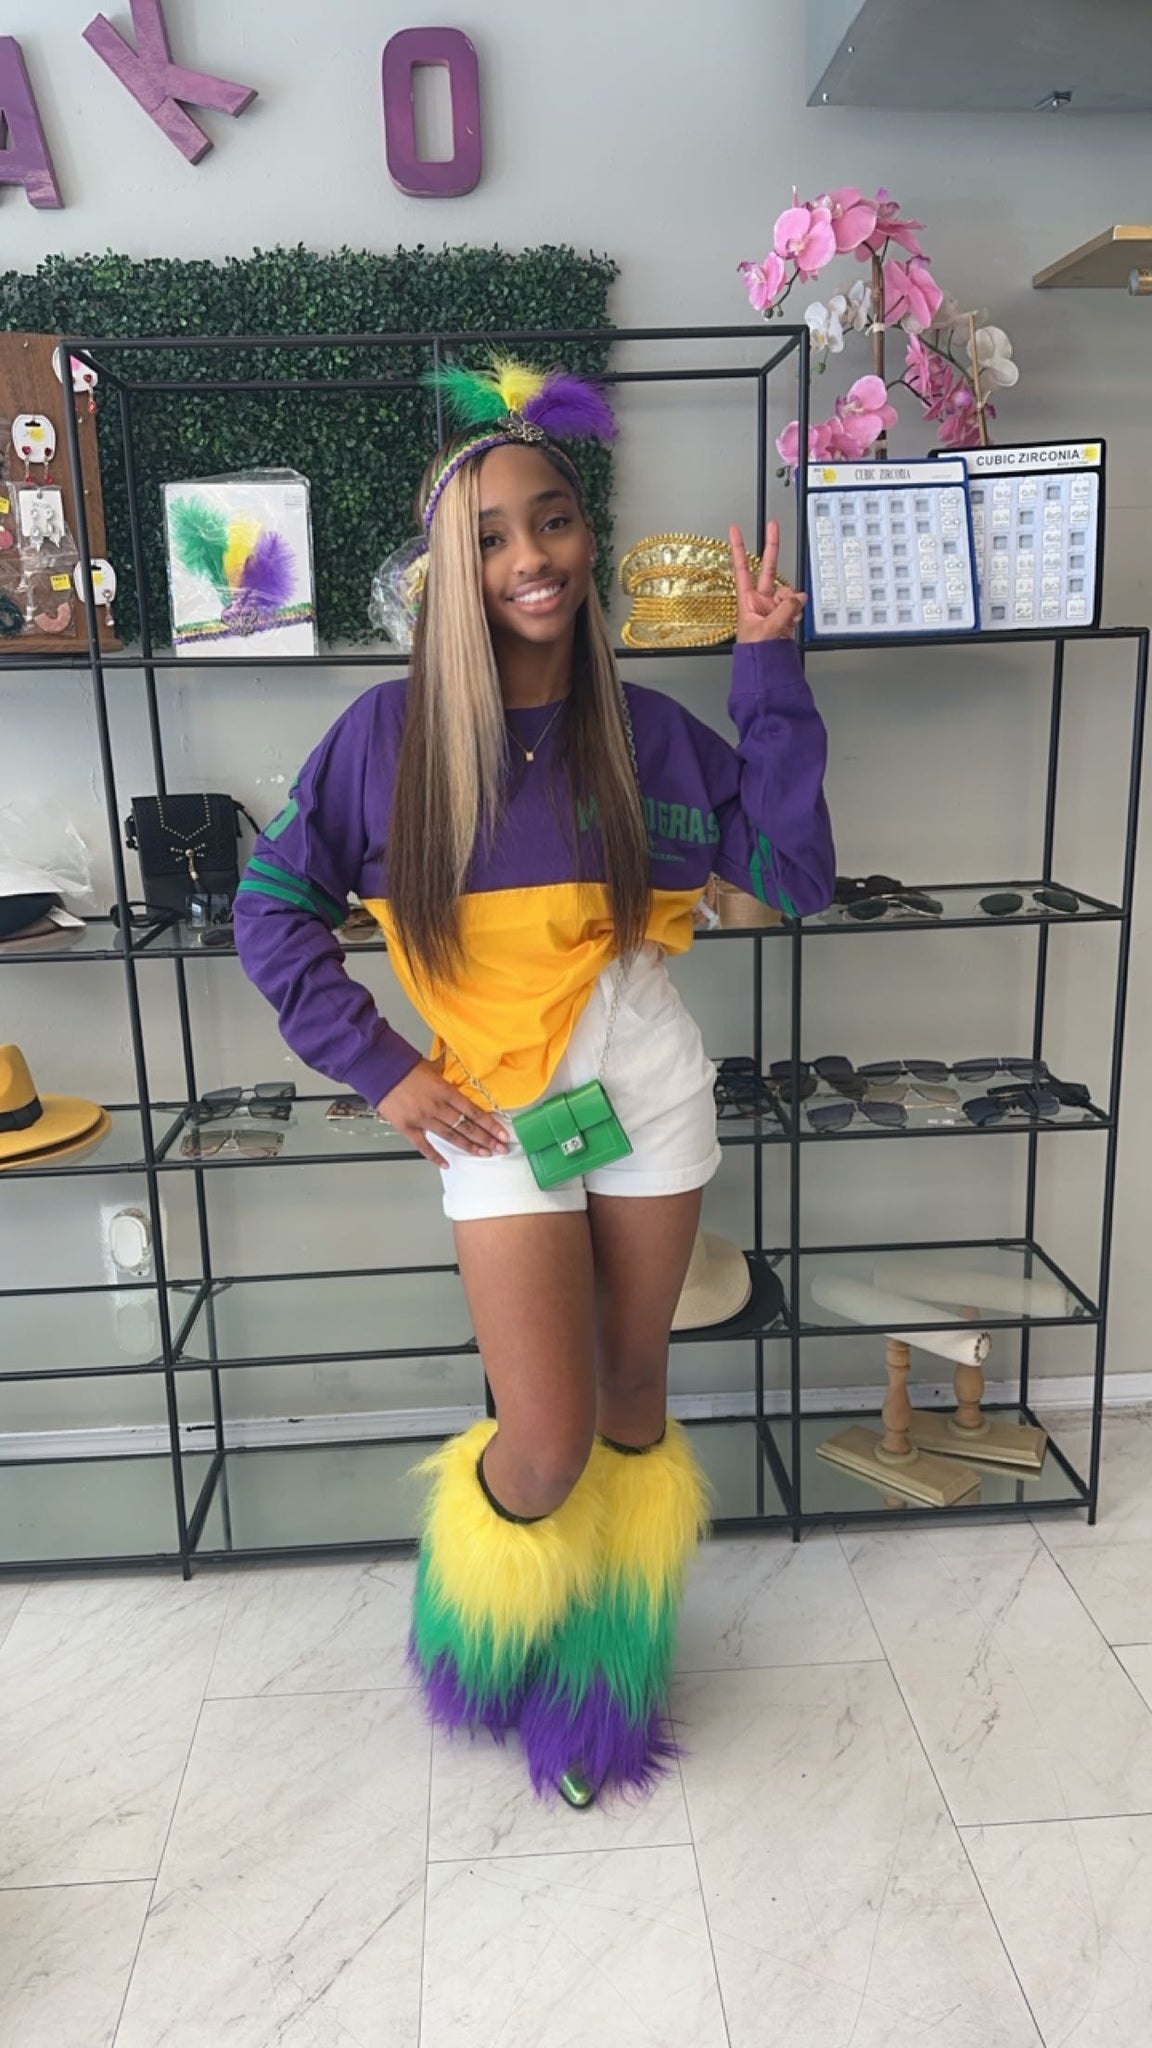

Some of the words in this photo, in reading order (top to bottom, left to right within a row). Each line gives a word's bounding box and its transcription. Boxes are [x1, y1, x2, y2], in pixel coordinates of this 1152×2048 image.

[976, 454, 1015, 467] CUBIC
[1018, 449, 1080, 464] ZIRCONIA
[854, 468, 876, 481] CUBIC
[879, 467, 912, 480] ZIRCONIA
